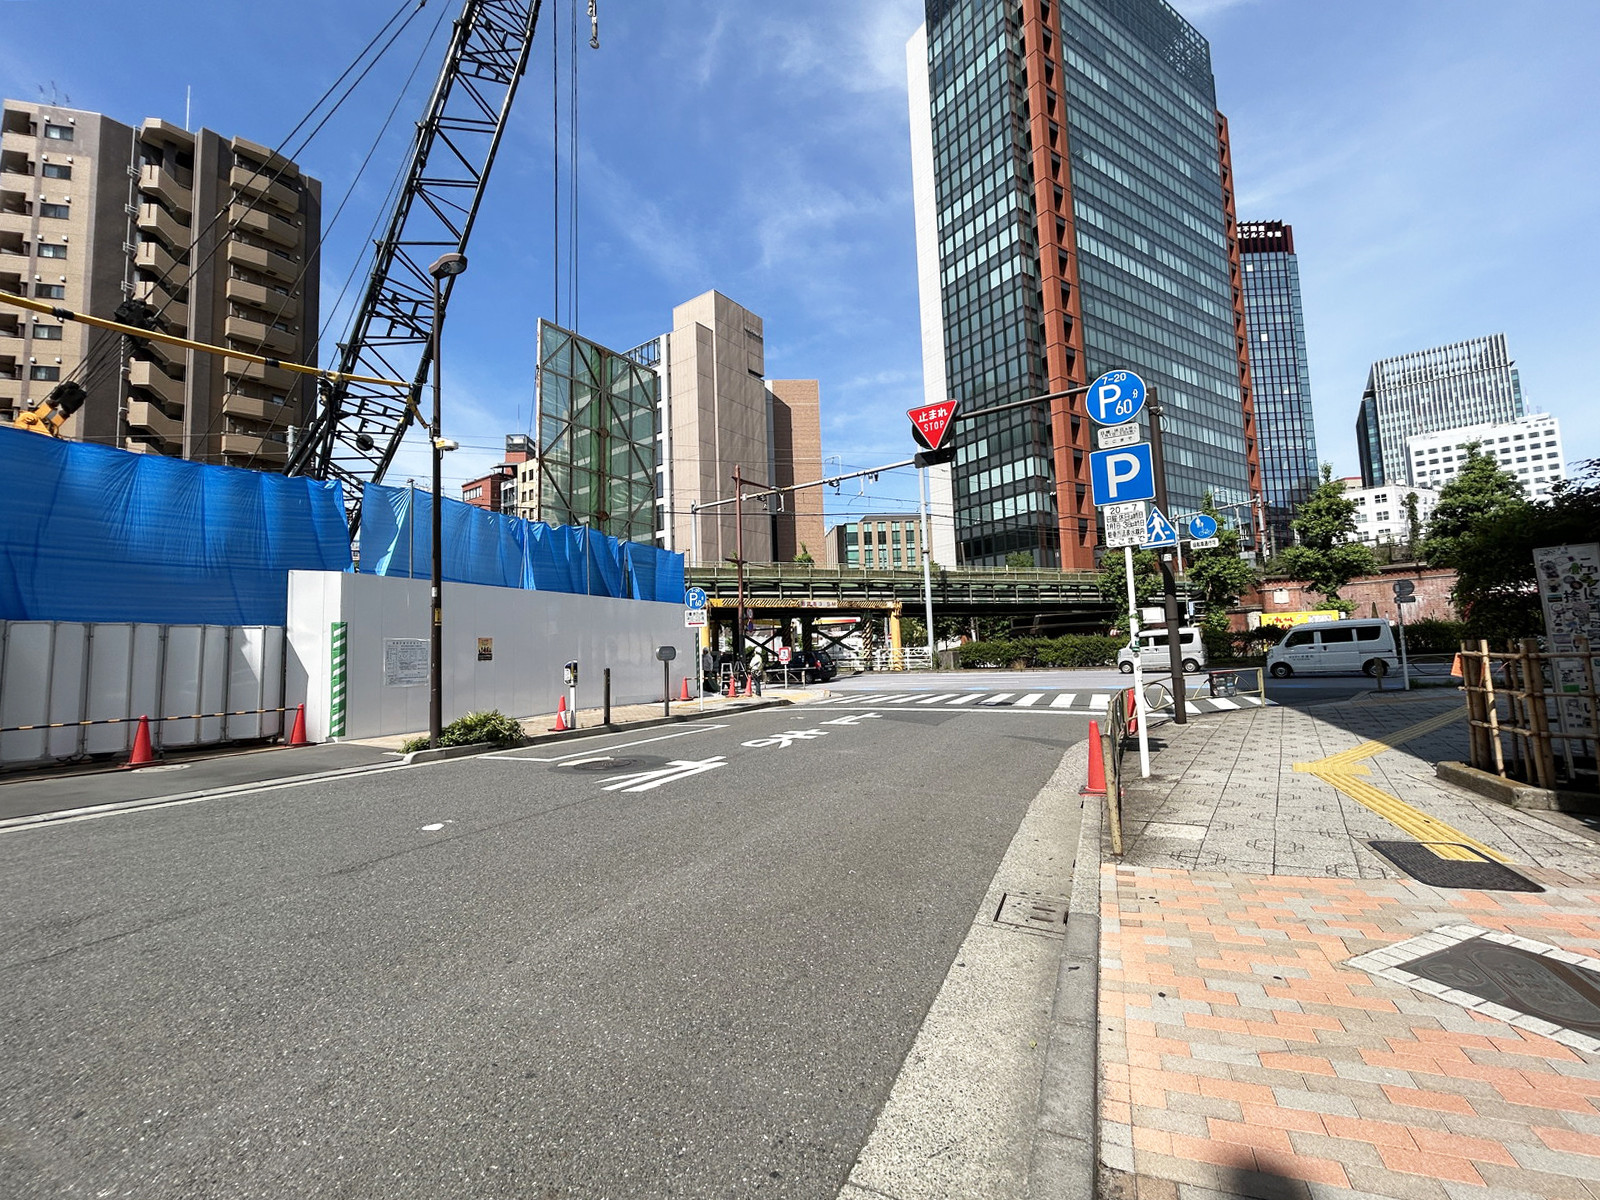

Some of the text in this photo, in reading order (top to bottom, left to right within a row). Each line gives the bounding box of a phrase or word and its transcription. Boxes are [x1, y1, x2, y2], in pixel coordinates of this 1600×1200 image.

[1102, 372, 1127, 385] 7-20
[1098, 384, 1122, 419] P
[1115, 398, 1132, 416] 60
[918, 407, 948, 423] 止まれ
[923, 420, 945, 432] STOP
[1105, 453, 1141, 498] P
[1108, 535, 1146, 546] ここまで
[689, 592, 698, 607] P
